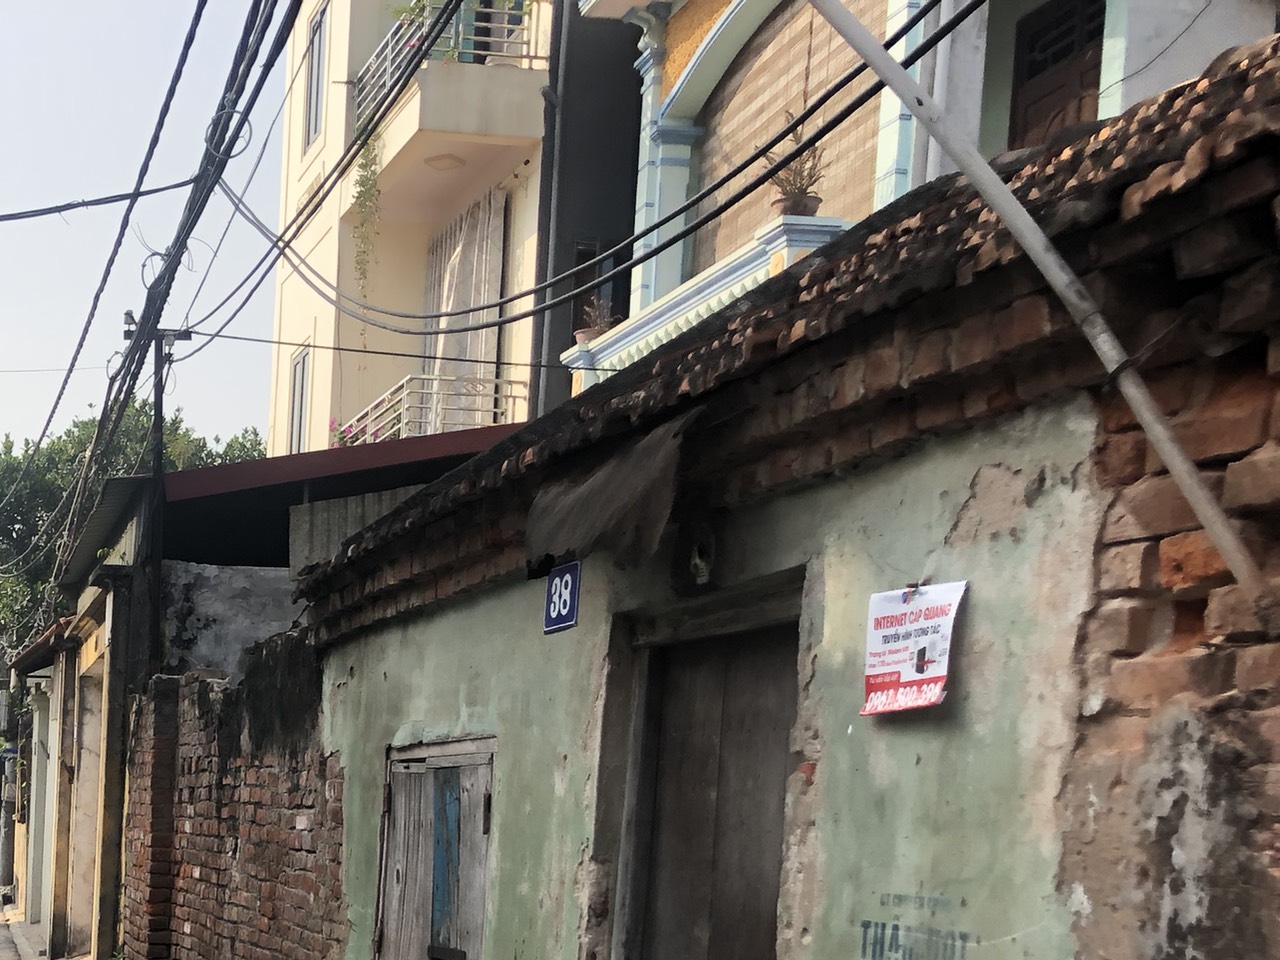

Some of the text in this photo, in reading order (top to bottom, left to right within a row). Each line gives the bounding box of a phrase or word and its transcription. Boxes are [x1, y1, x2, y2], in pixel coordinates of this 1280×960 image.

[550, 573, 572, 619] 38
[873, 612, 908, 631] INTERNET
[923, 603, 952, 621] QUANG
